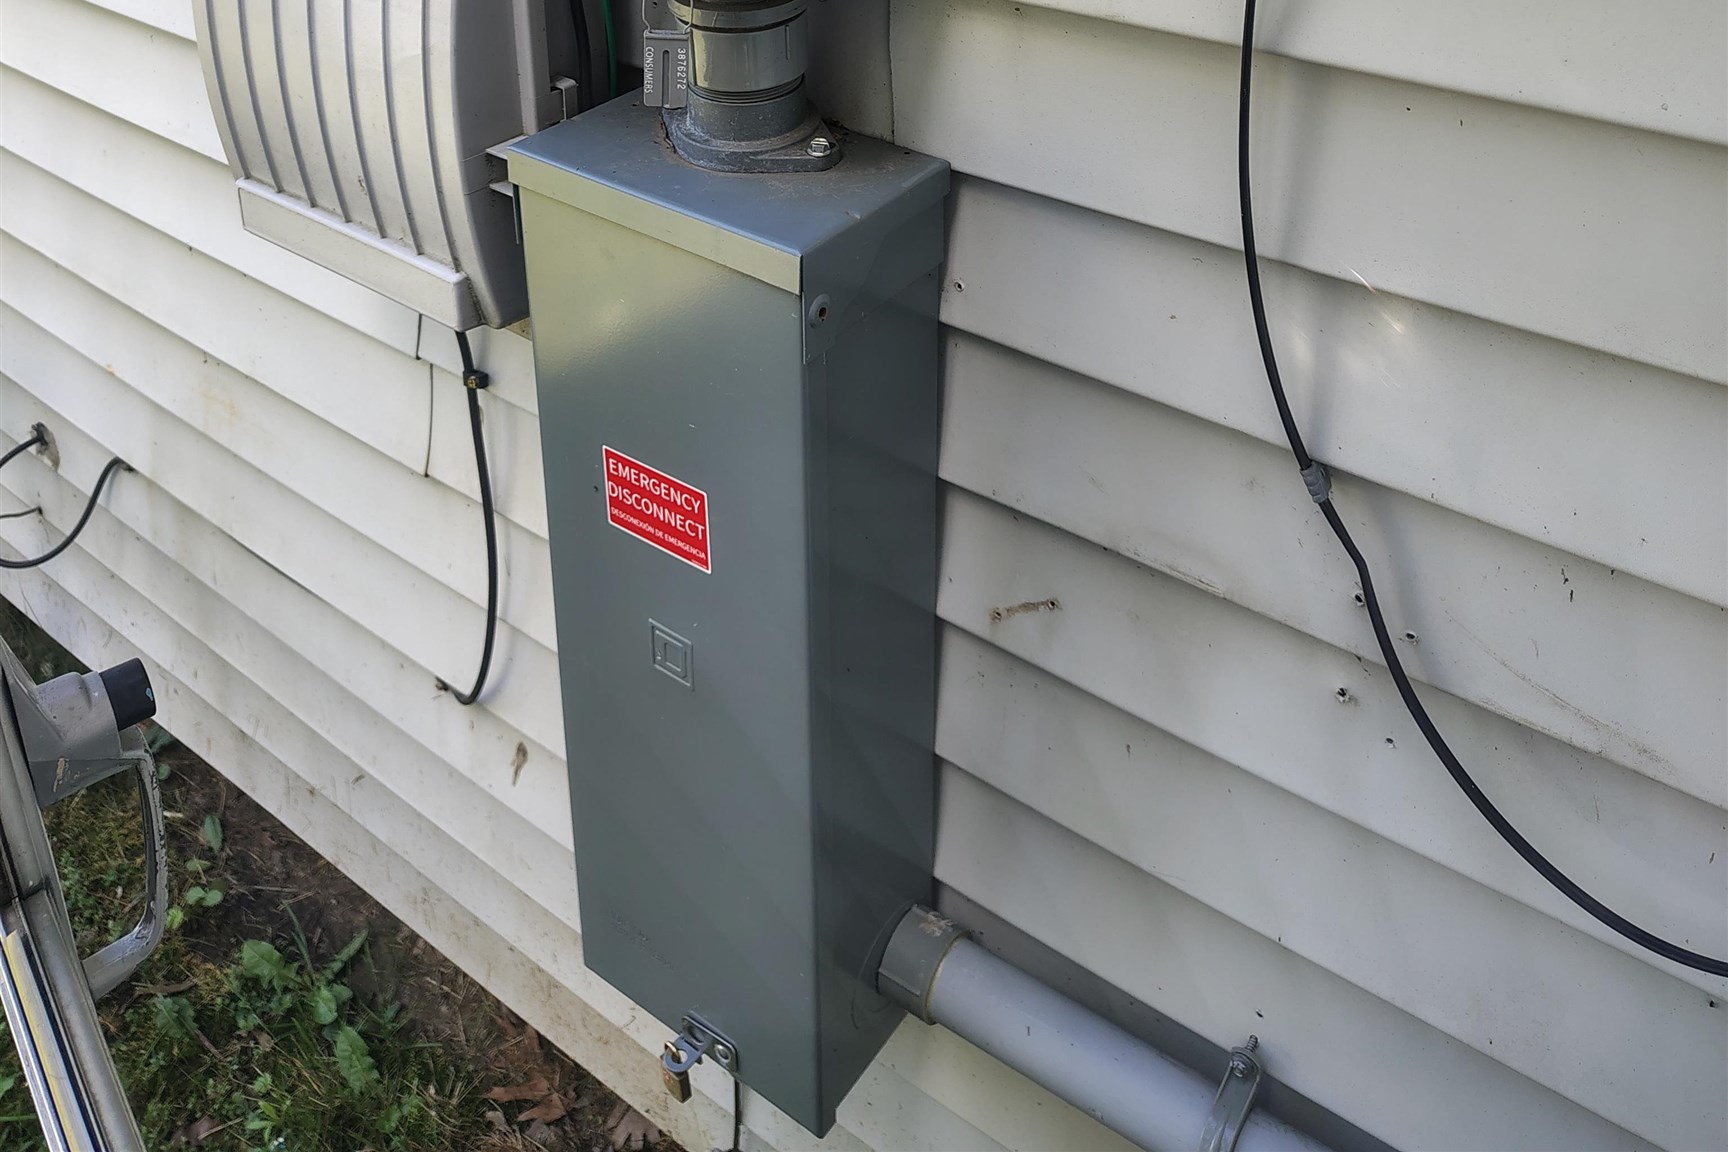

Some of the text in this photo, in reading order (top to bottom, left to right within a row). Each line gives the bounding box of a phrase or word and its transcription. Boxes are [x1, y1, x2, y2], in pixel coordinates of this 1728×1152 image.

[644, 47, 654, 94] CONSUMERS
[677, 48, 686, 90] 3876272
[609, 458, 701, 514] EMERGENCY
[609, 481, 704, 540] DISCONNECT
[611, 506, 706, 560] DESCONEXIÓN DE EMERGENCIA
